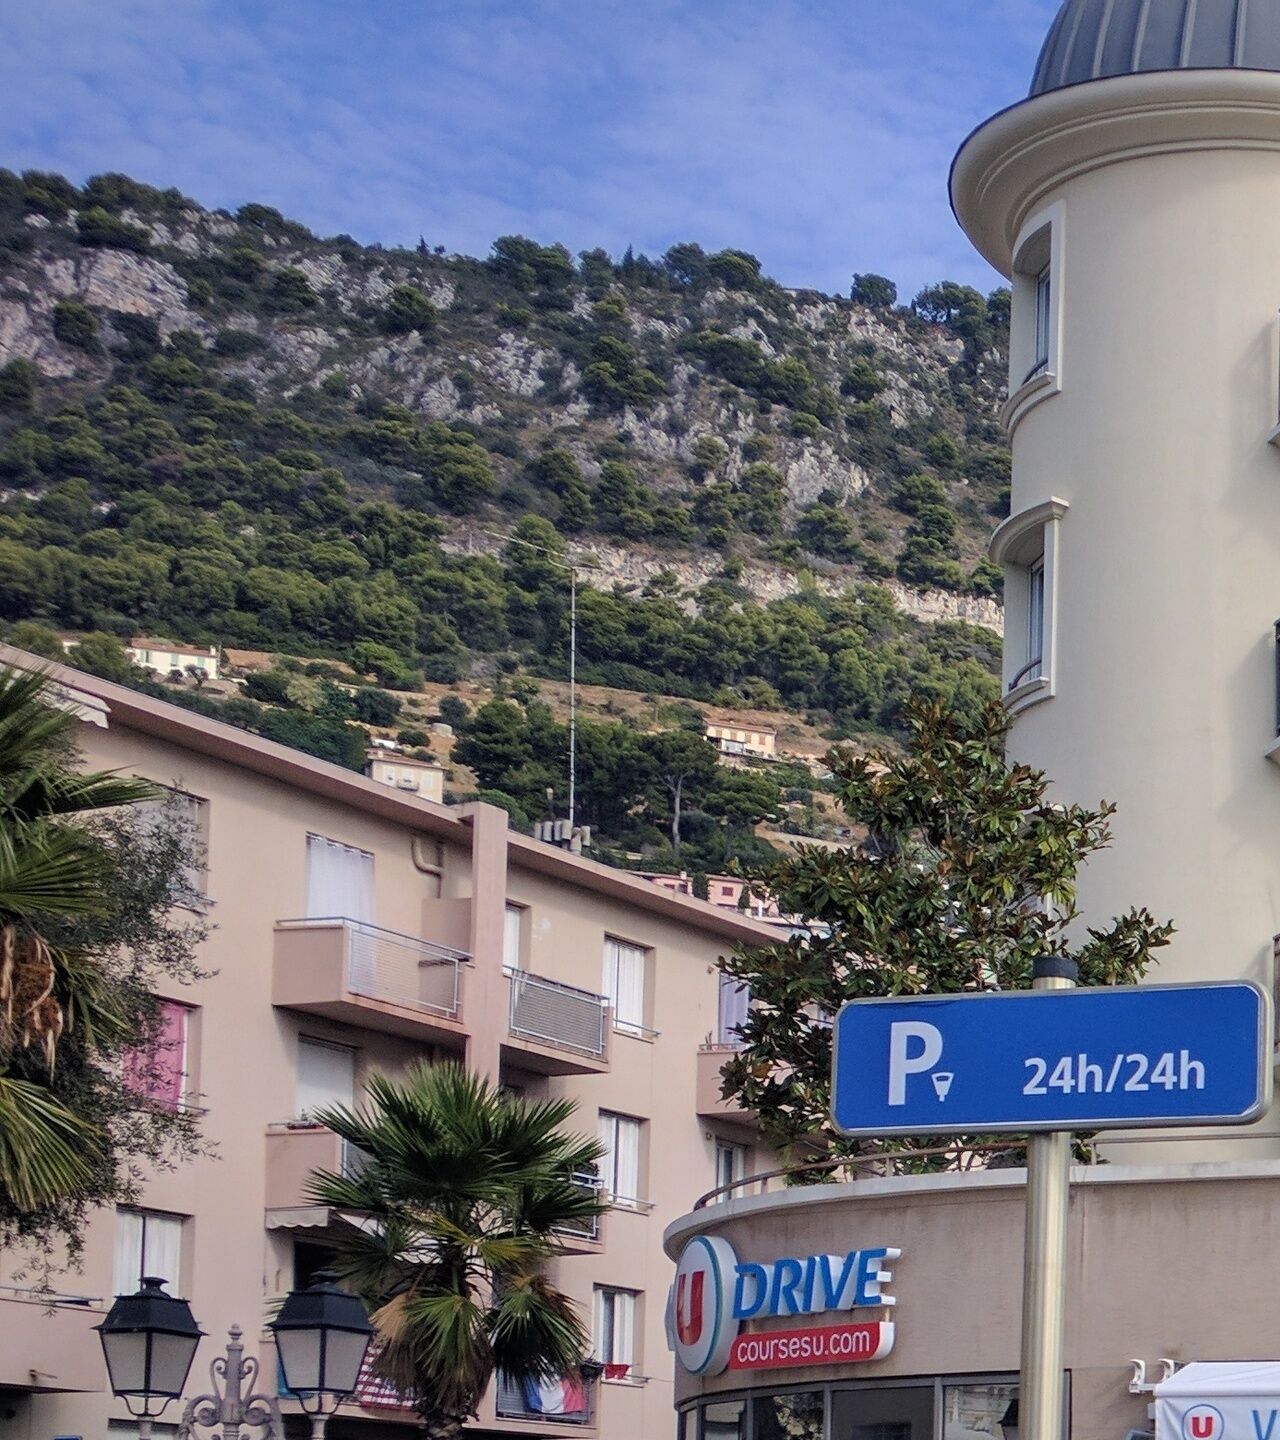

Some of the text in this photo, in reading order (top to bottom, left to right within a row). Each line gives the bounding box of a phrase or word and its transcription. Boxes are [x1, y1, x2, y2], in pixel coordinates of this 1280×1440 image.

[888, 1021, 1206, 1106] P 24h/24h
[675, 1248, 898, 1346] U DRIVE
[736, 1328, 871, 1363] coursesu.com
[1191, 1416, 1214, 1439] U
